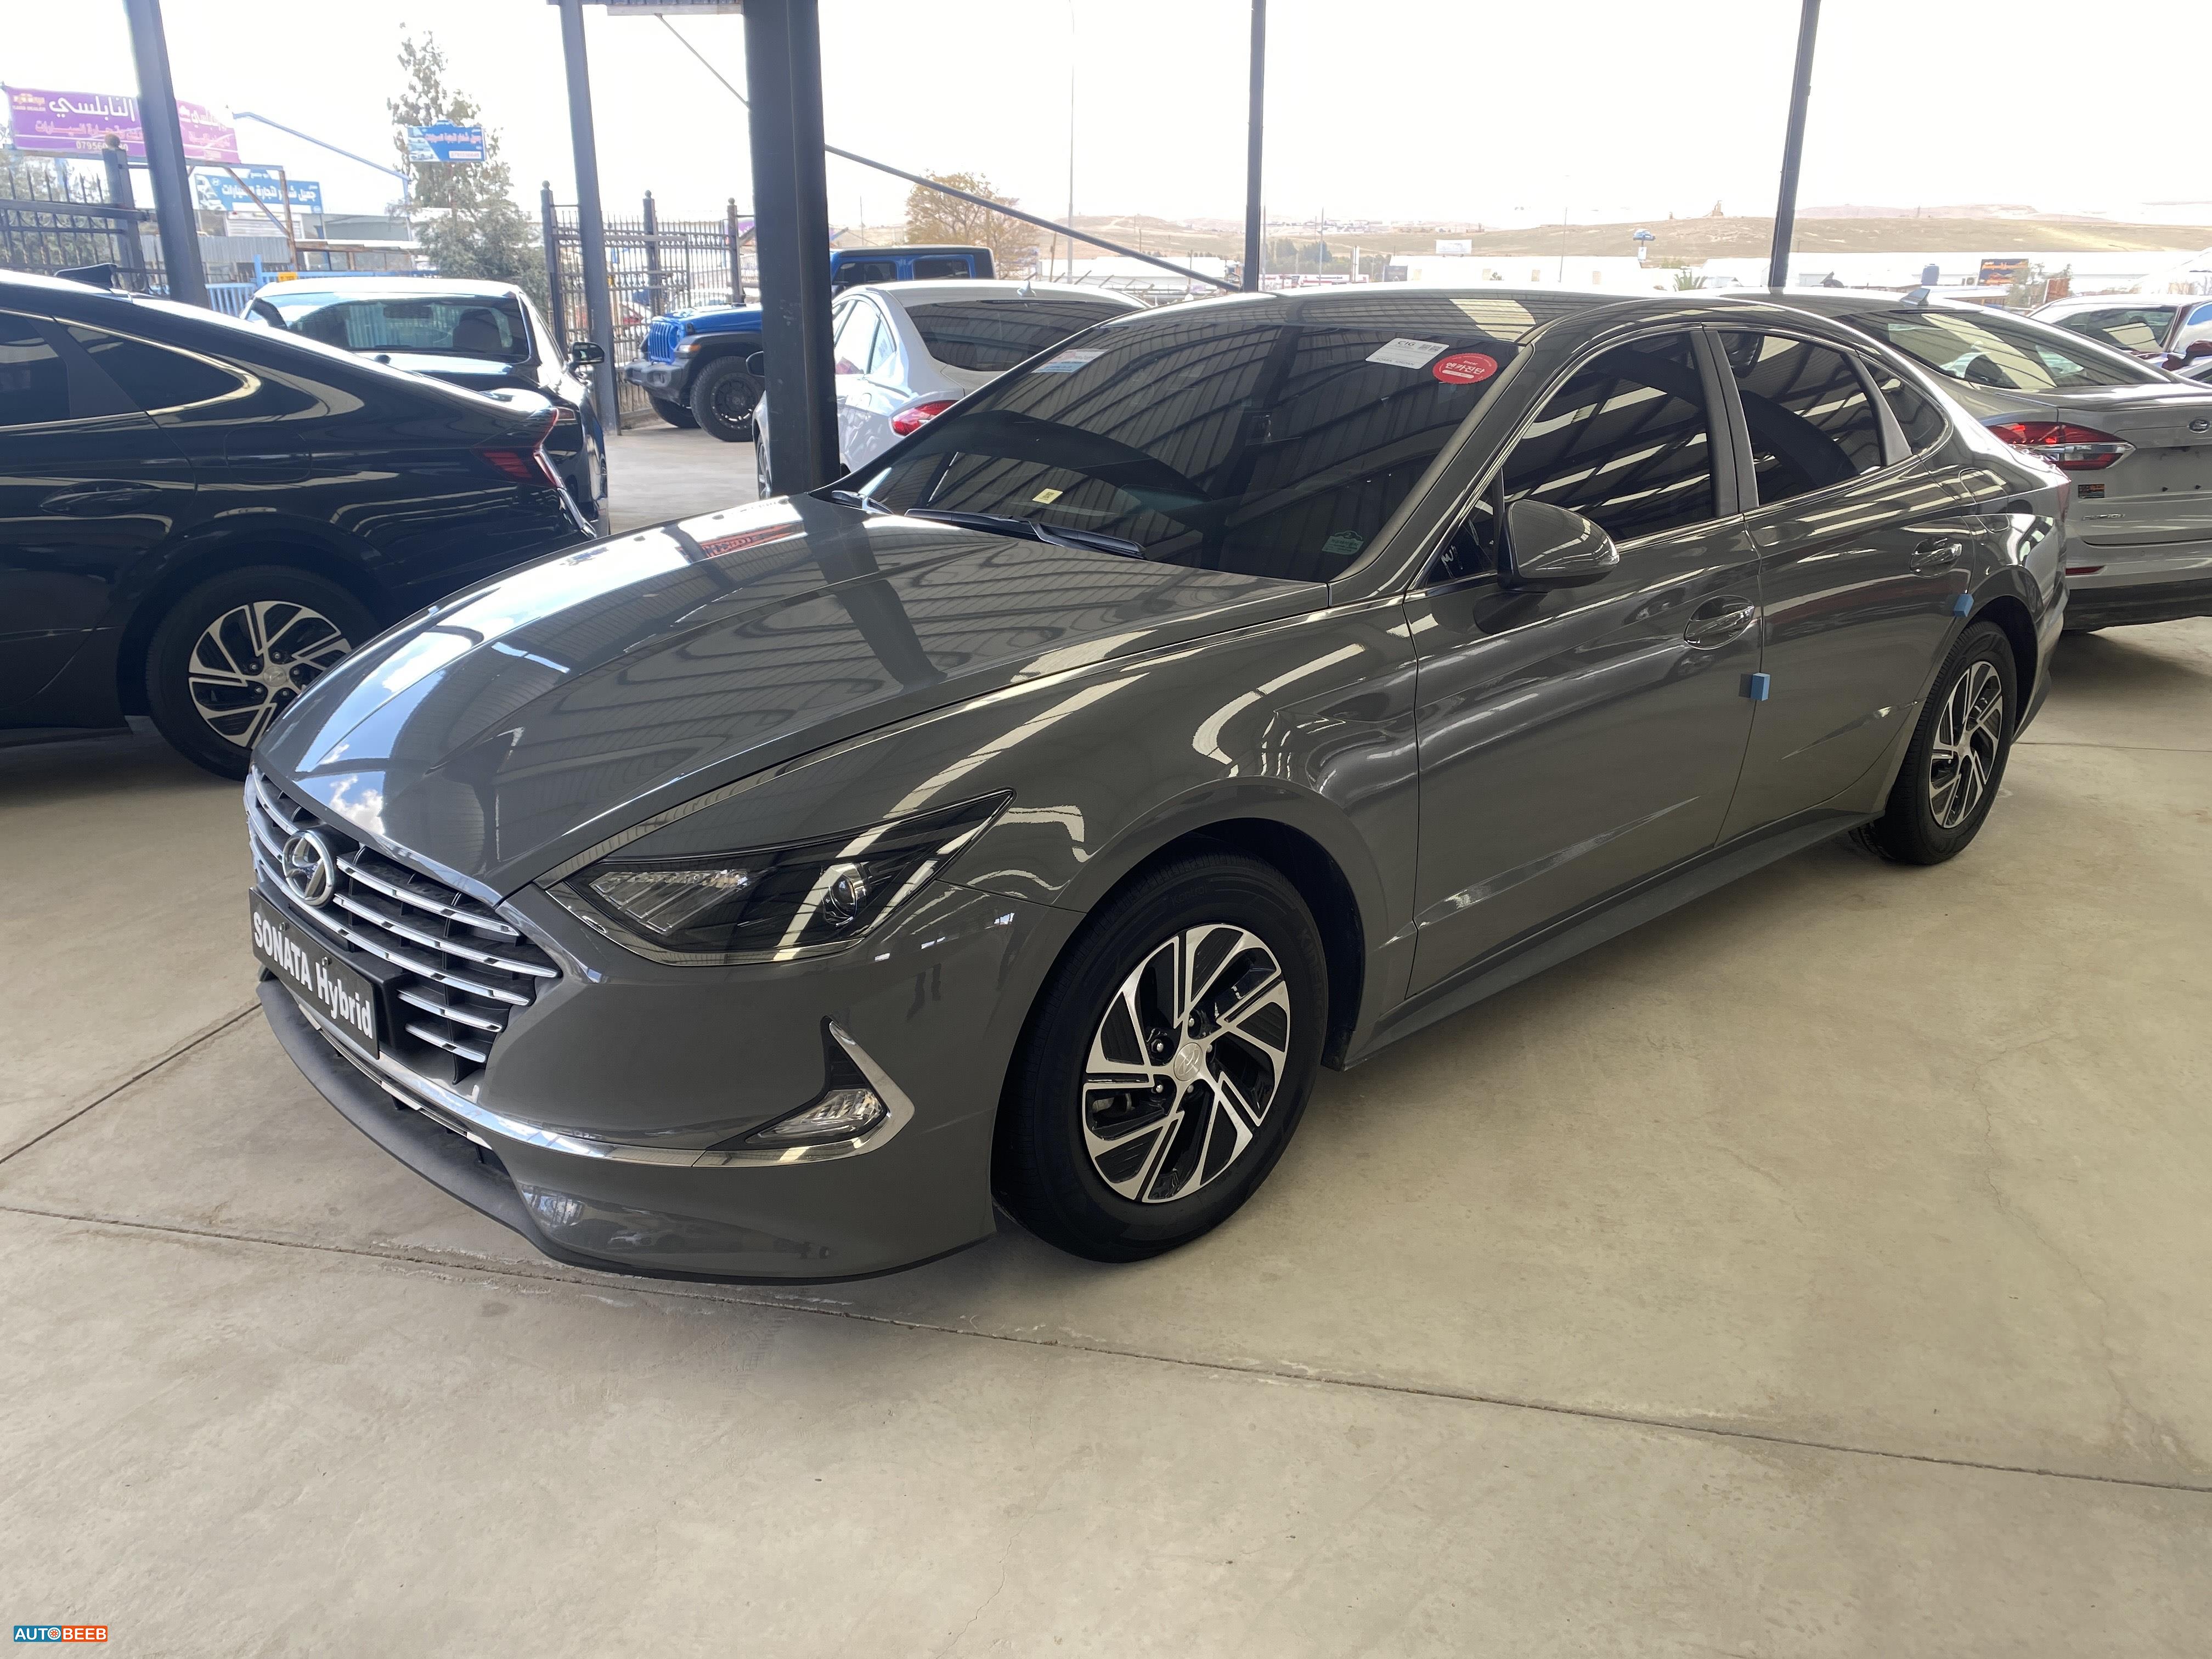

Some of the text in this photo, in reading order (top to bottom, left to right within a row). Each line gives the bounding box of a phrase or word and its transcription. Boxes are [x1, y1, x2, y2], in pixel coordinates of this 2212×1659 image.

[49, 95, 136, 122] النابلسي
[1445, 362, 1485, 375] 엔카진단
[253, 911, 373, 1039] SONATA Hybrid
